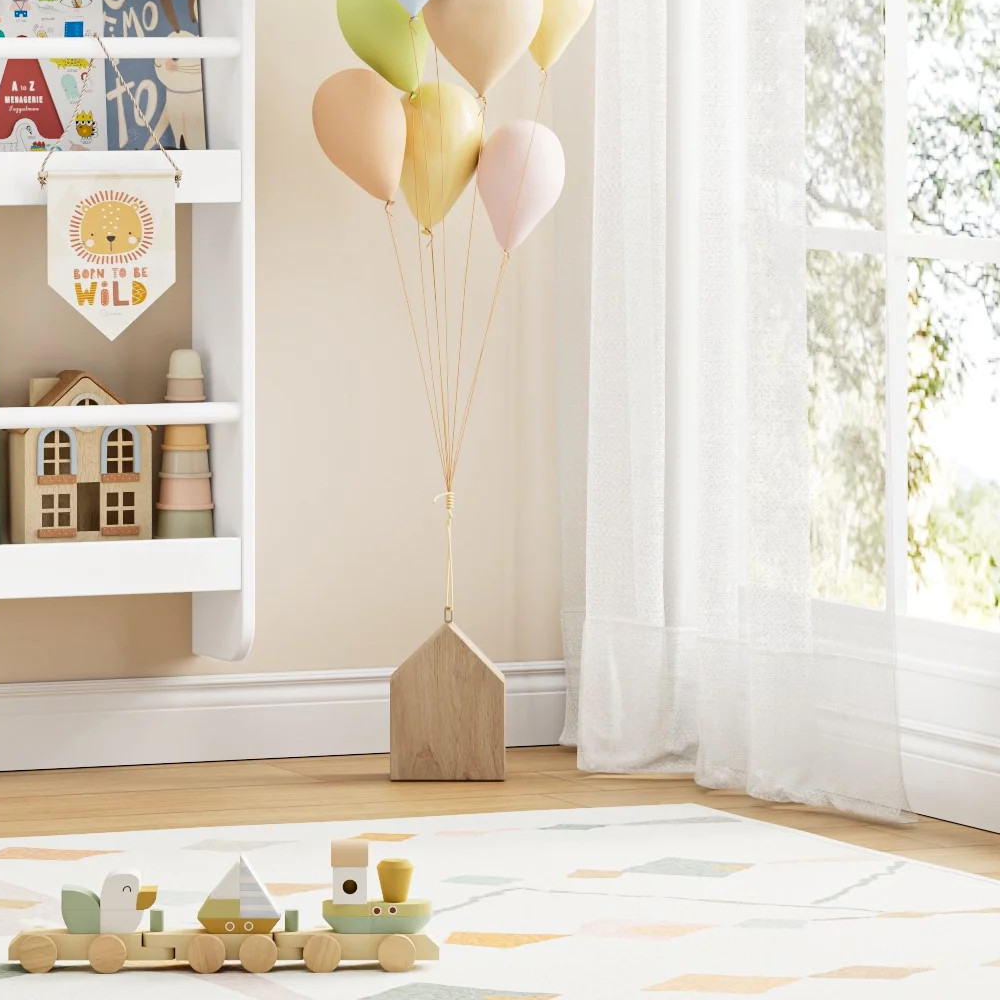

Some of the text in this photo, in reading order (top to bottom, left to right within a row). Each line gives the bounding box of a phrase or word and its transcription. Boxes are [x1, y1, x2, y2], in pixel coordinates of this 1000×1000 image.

[11, 81, 36, 92] A to Z
[4, 95, 44, 104] MENAGERIE
[73, 266, 148, 279] BORN TO BE
